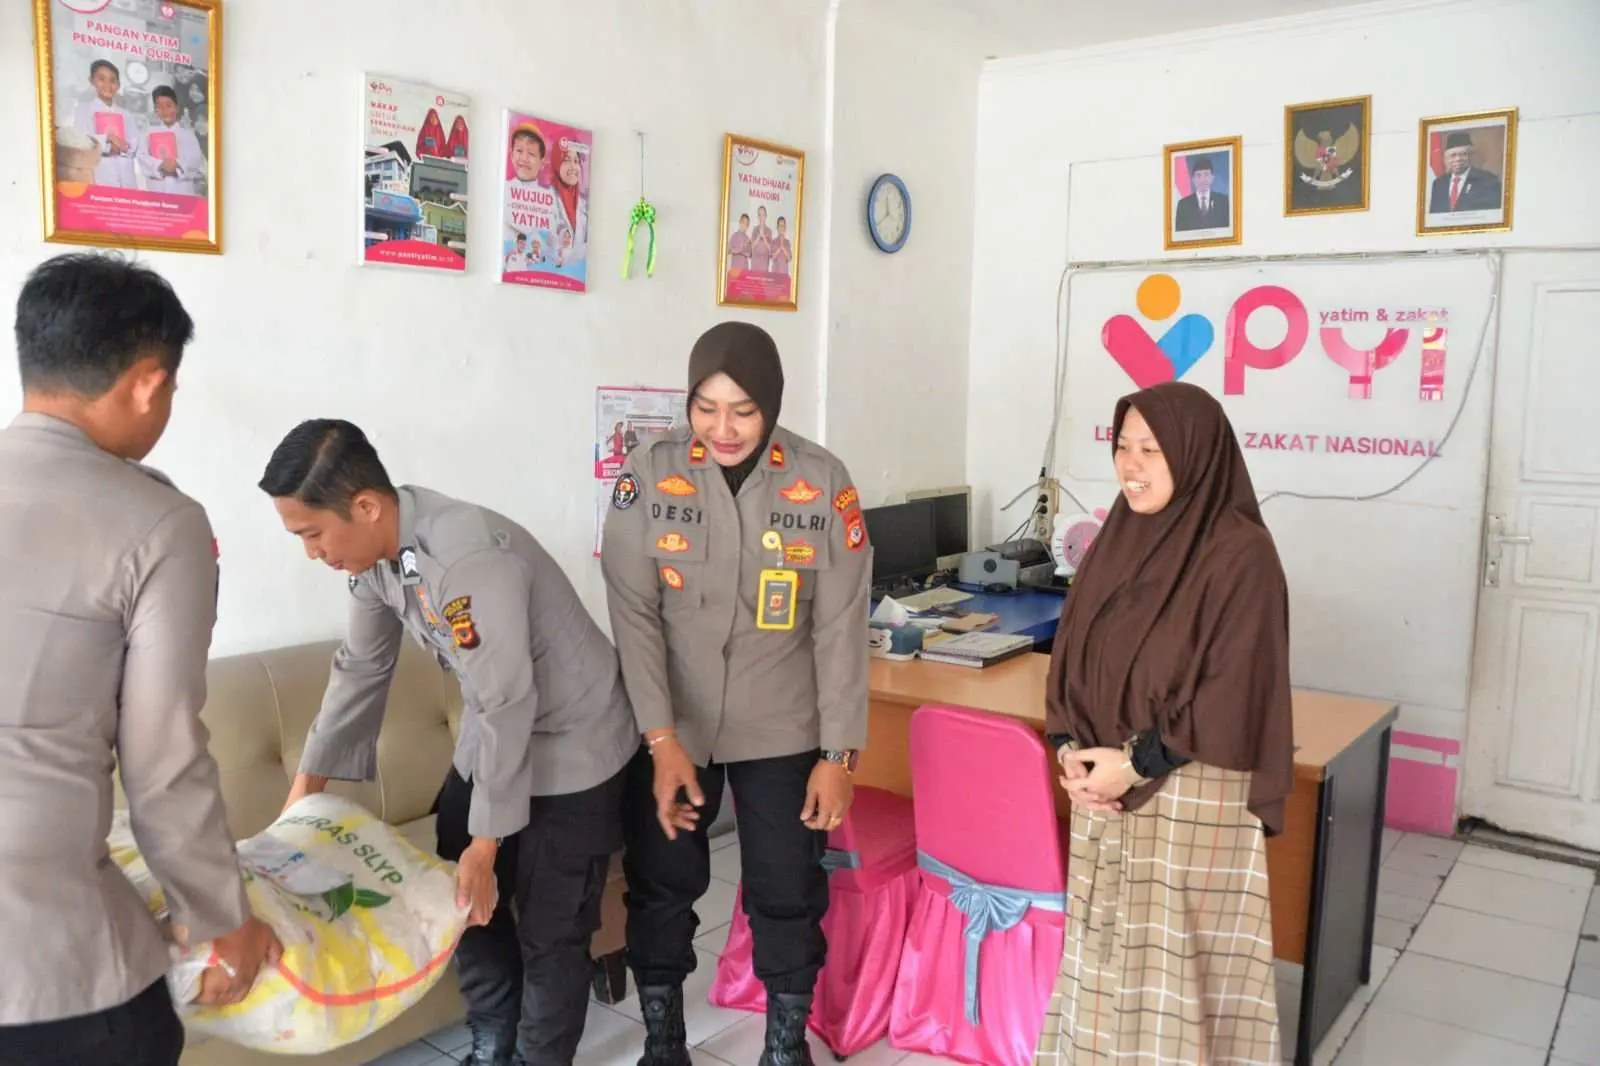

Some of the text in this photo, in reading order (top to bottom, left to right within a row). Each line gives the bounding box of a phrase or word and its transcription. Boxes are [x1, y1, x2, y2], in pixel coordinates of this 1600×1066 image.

[72, 32, 144, 55] PENGHAFAL
[86, 20, 178, 48] PANGAN YATIM
[737, 172, 761, 185] YATIM
[510, 187, 553, 206] WUJUD
[512, 211, 550, 229] YATIM
[1319, 307, 1369, 325] yatim
[1376, 307, 1389, 322] &
[1244, 431, 1442, 458] ZAKAT NASIONAL
[651, 503, 702, 524] DESI
[769, 511, 826, 531] POLRI
[353, 844, 403, 883] SLYP
